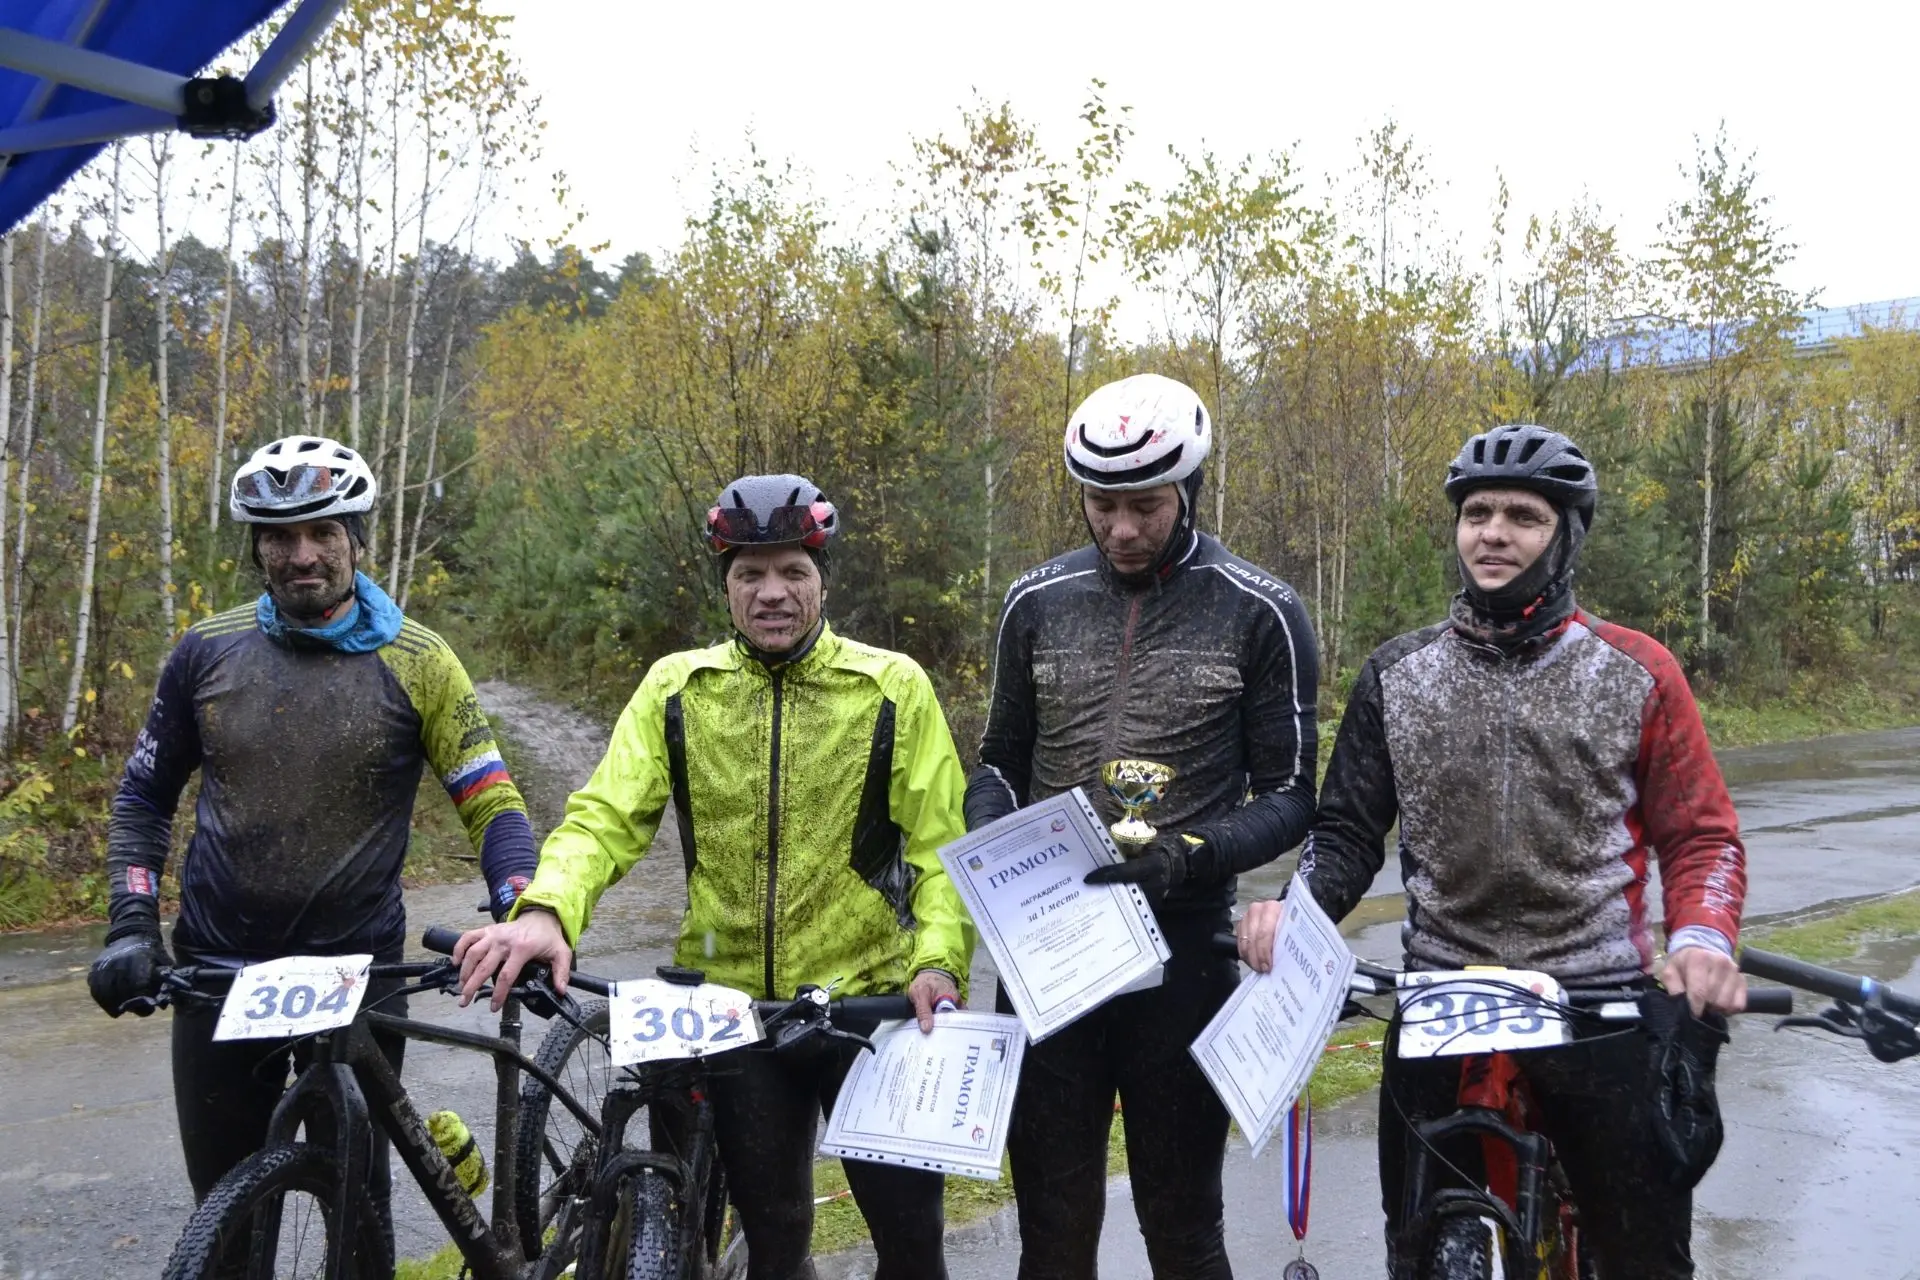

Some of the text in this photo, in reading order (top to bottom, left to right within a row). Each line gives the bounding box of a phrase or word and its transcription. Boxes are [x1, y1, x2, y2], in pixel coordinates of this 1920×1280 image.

[1225, 562, 1283, 591] CRAFT
[988, 842, 1070, 889] ГРАМОТА
[1020, 876, 1072, 908] НАГРАЖДАЕТСЯ
[1027, 890, 1080, 923] за 1 место
[1284, 933, 1321, 994] ГРАМОТА
[244, 984, 350, 1020] 304
[1421, 992, 1544, 1036] 303
[632, 1007, 743, 1042] 302
[916, 1076, 927, 1111] место
[952, 1044, 981, 1128] ГРАМОТА
